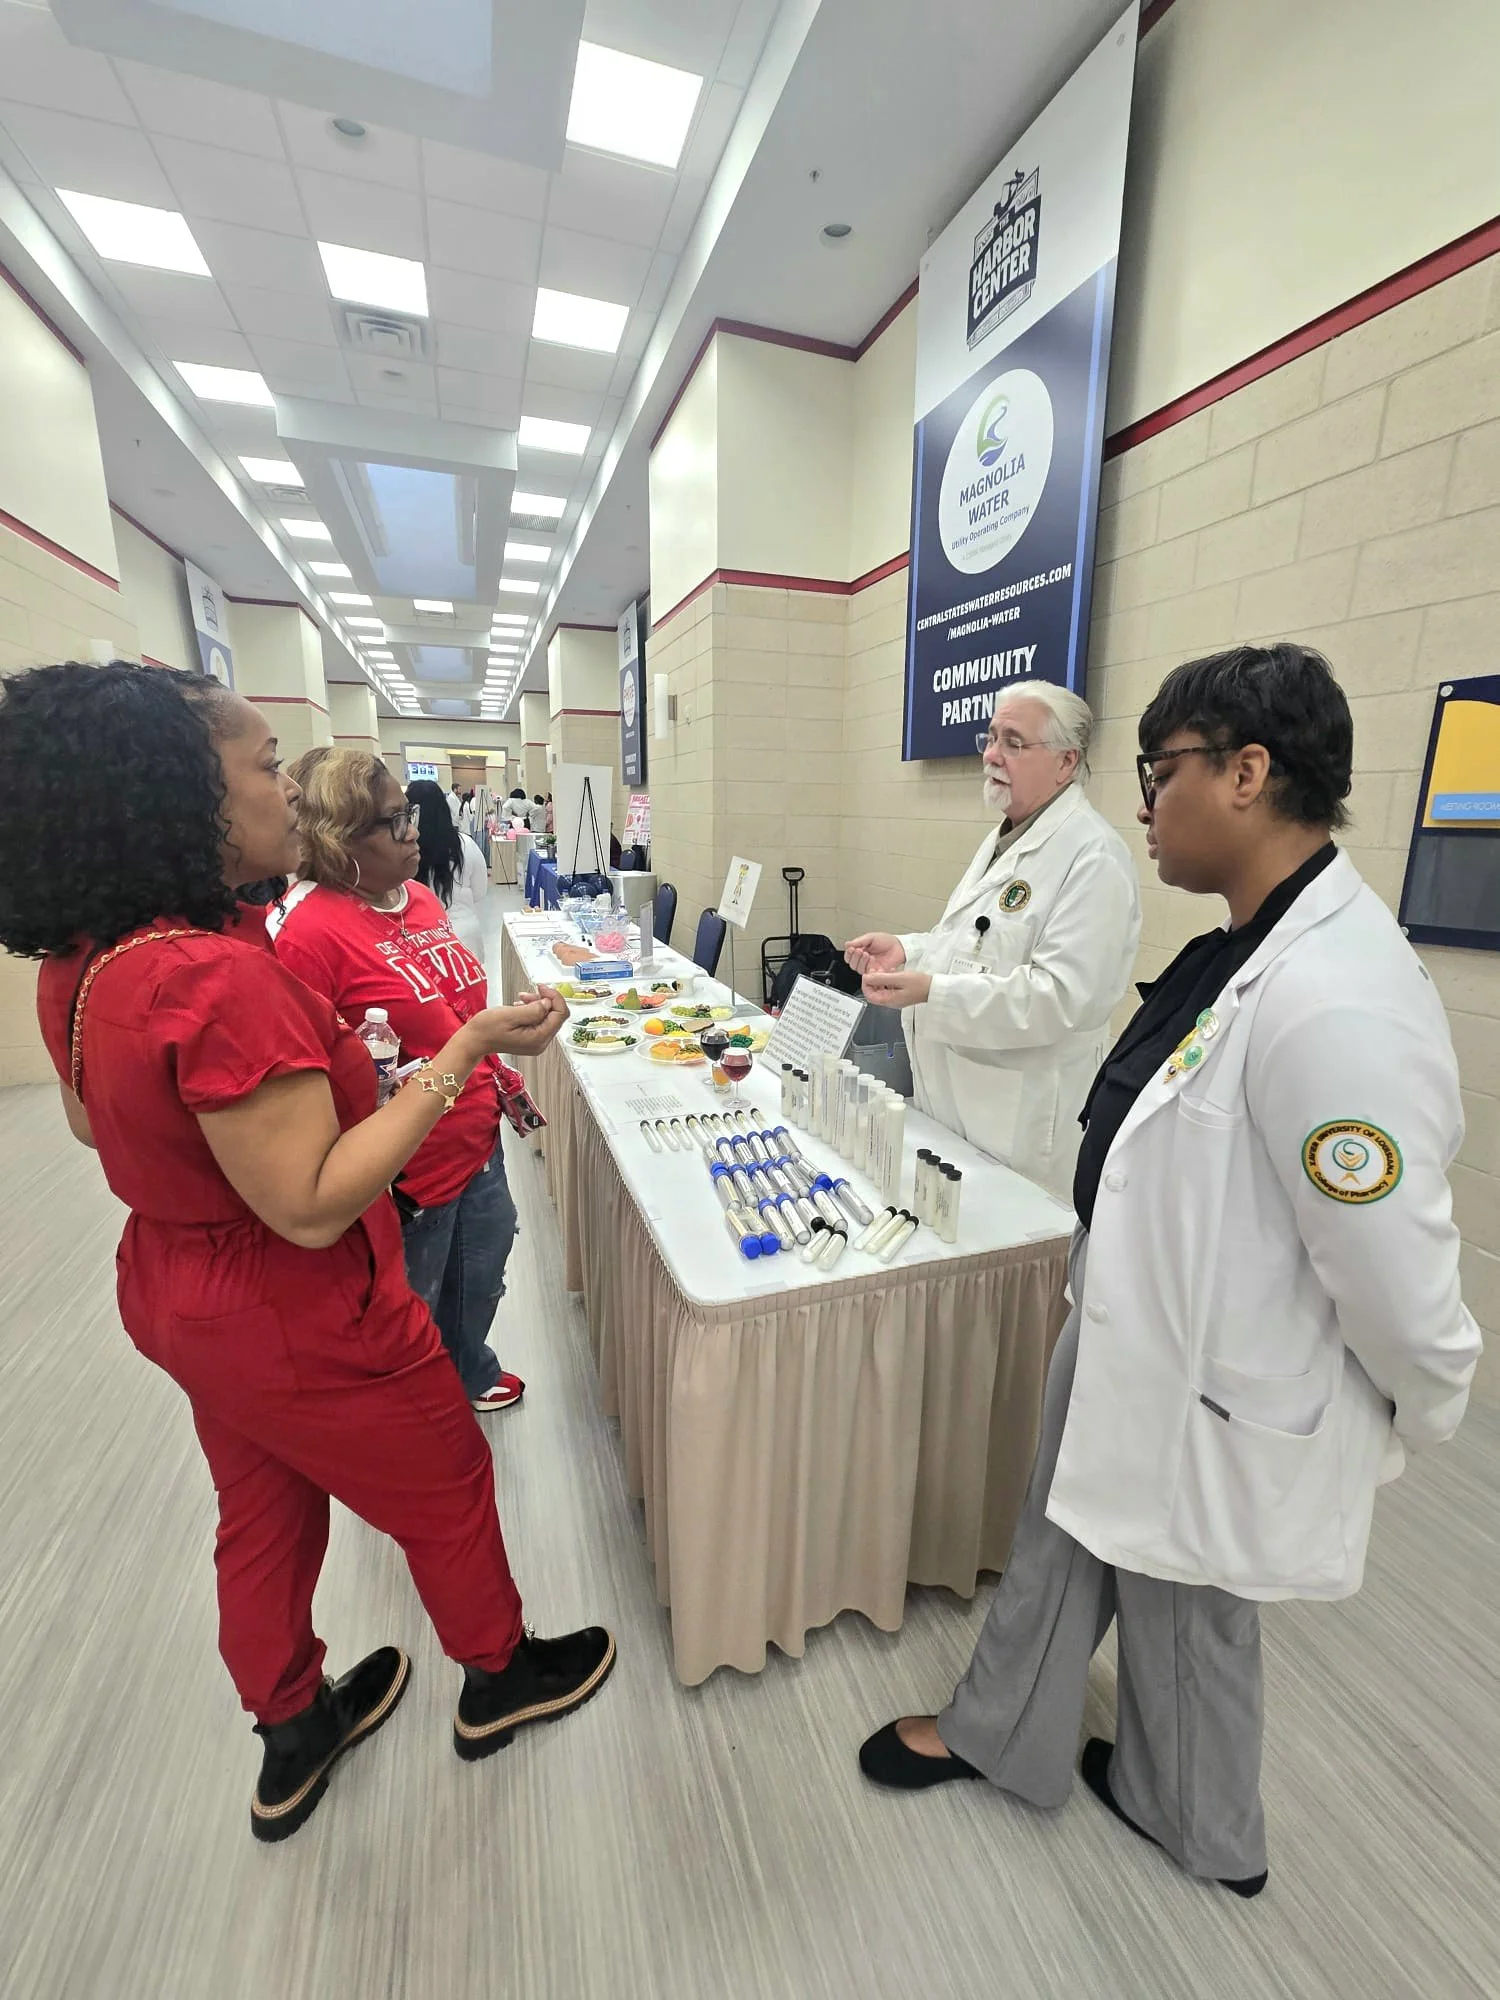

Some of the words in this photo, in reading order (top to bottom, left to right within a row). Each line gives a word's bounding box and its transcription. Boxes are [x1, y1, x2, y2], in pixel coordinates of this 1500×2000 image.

[972, 207, 1036, 297] HARBOR
[973, 241, 1031, 320] CENTER
[959, 453, 1026, 507] MAGNOLIA
[951, 536, 969, 551] Utility
[969, 520, 999, 541] Operating
[999, 505, 1030, 526] Company
[968, 488, 1010, 526] WATER
[917, 563, 1072, 631] CENTRALSTATESWATERRESOURCES.COM
[947, 606, 1021, 641] /MAGNOLIA-WATER
[932, 643, 1038, 693] COMMUNITY
[941, 691, 996, 726] PARTN
[1316, 1125, 1362, 1142] UNIVERSITY
[1363, 1129, 1377, 1138] OF
[1375, 1137, 1395, 1176] LOUISIANA
